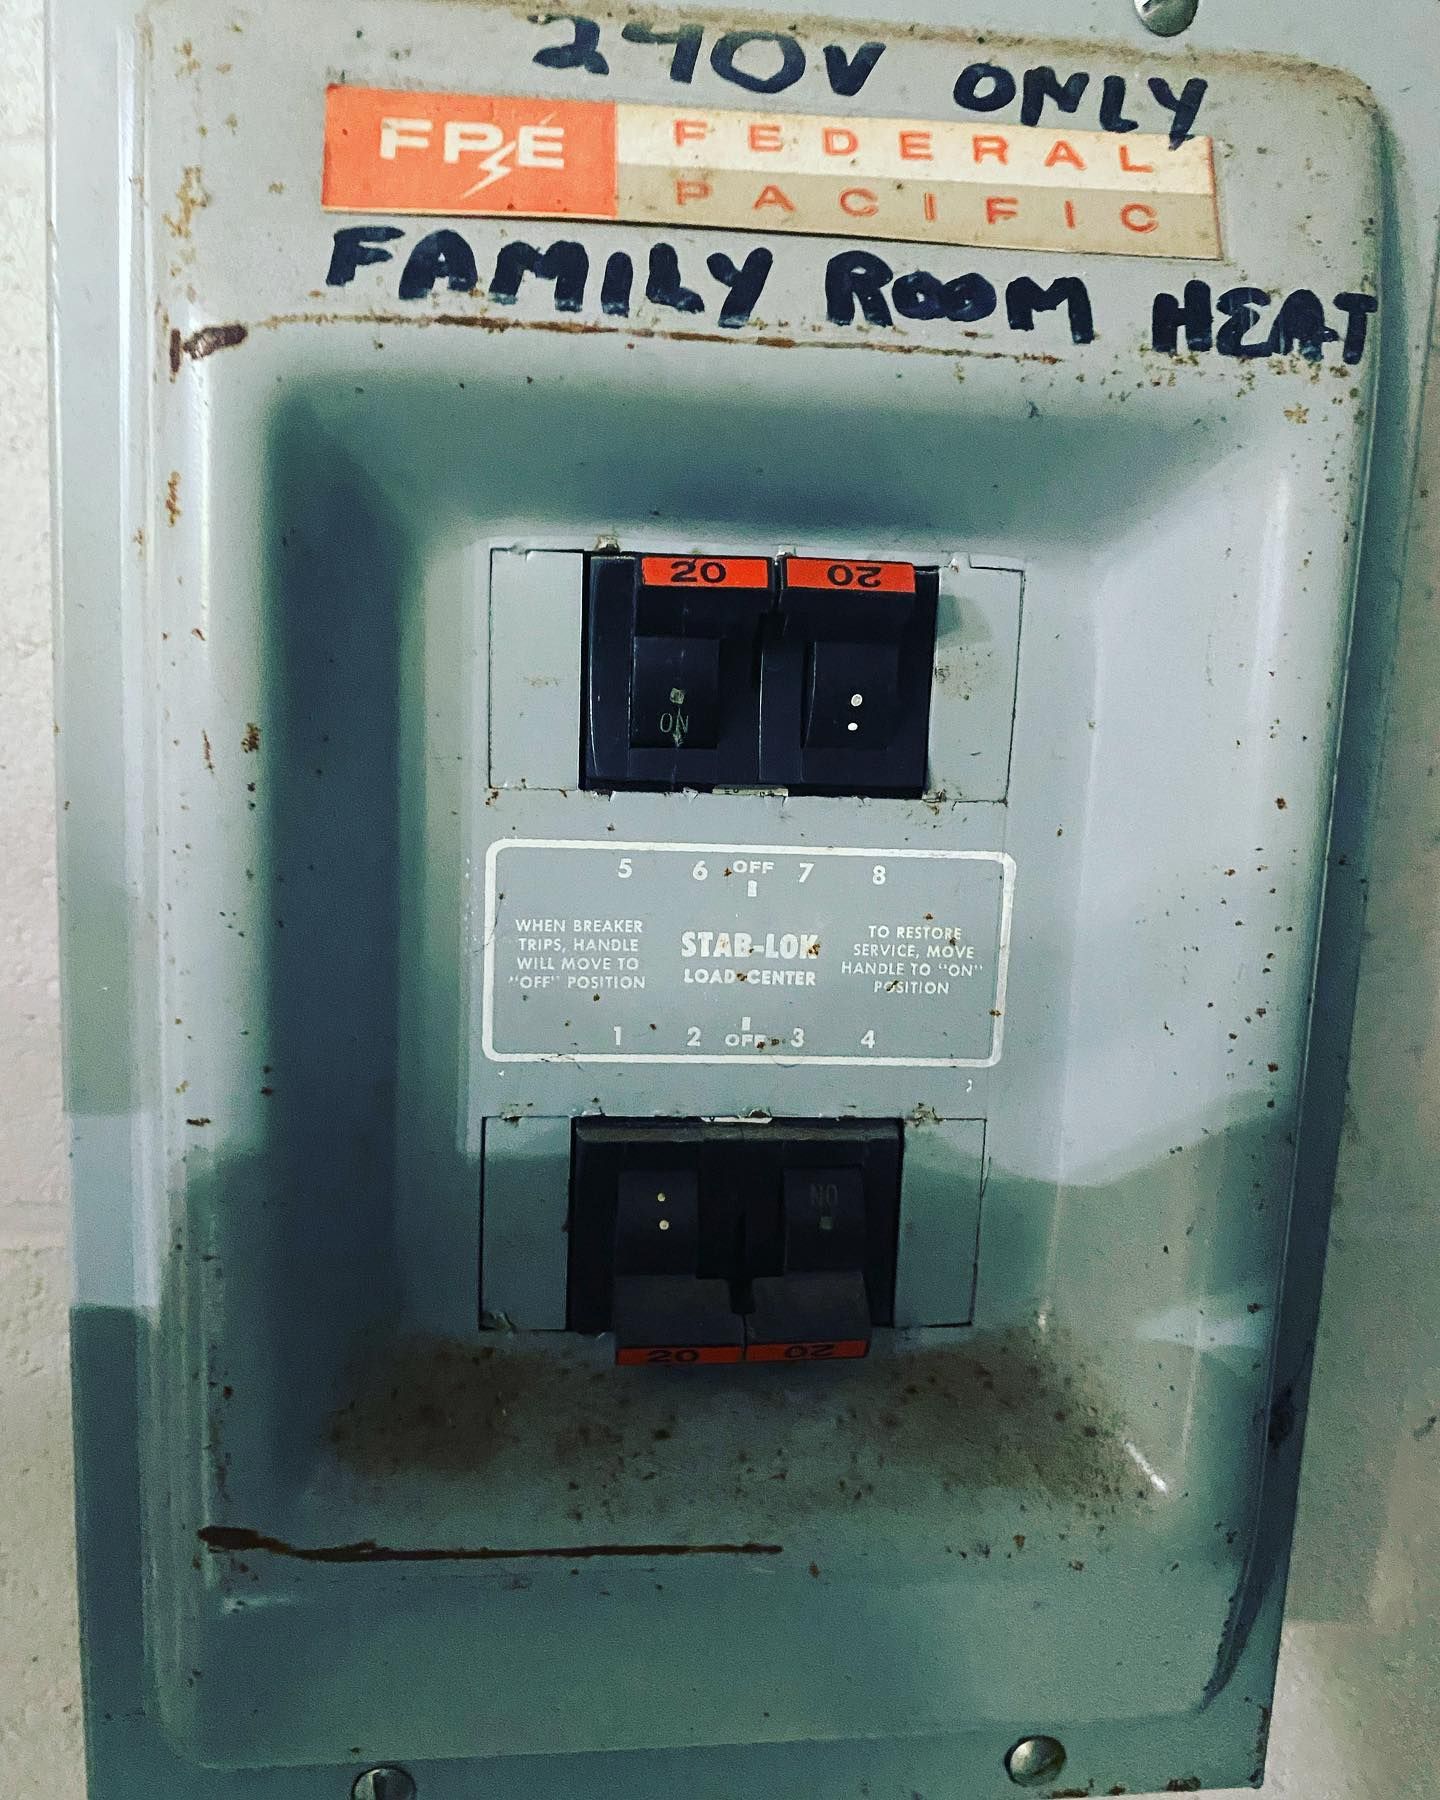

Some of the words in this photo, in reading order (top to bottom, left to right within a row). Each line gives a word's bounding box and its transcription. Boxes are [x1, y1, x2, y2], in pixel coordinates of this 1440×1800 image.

[527, 15, 886, 97] 240V
[953, 61, 1208, 151] ONLY
[379, 114, 565, 171] FPE
[674, 119, 1154, 175] FEDERAL
[675, 180, 1160, 235] PACIFIC
[325, 226, 773, 328] FAMILY
[824, 250, 1095, 345] ROOM
[1152, 279, 1379, 365] HEAT
[670, 560, 727, 584] 20
[659, 711, 690, 734] ON
[617, 857, 633, 879] 5
[692, 860, 709, 881] 6
[732, 860, 775, 874] OFF
[799, 862, 815, 883] 7
[872, 864, 887, 886] 8
[515, 918, 566, 933] WHEN
[573, 919, 644, 934] BREAKER
[868, 925, 890, 939] TO
[896, 926, 962, 941] RESTORE
[518, 937, 567, 953] TRIPS,
[573, 938, 640, 952] HANDLE
[681, 930, 820, 960] STAB-LOK
[853, 943, 920, 959] SERVICE,
[926, 944, 975, 960] MOVE
[516, 957, 555, 971] WILL
[561, 957, 612, 971] MOVE
[617, 957, 640, 971] TO
[841, 960, 905, 976] HANDLE
[910, 962, 931, 976] TO
[938, 963, 983, 977] "ON"
[507, 975, 561, 989] "OFF"
[567, 975, 646, 990] POSITION
[683, 968, 736, 984] LOAD
[747, 969, 817, 986] CENTER
[873, 980, 950, 994] POSITION
[613, 1025, 622, 1046] 1
[687, 1026, 701, 1047] 2
[724, 1033, 767, 1047] OFF
[790, 1027, 805, 1048] 3
[860, 1029, 876, 1049] 4
[647, 1349, 699, 1364] 20
